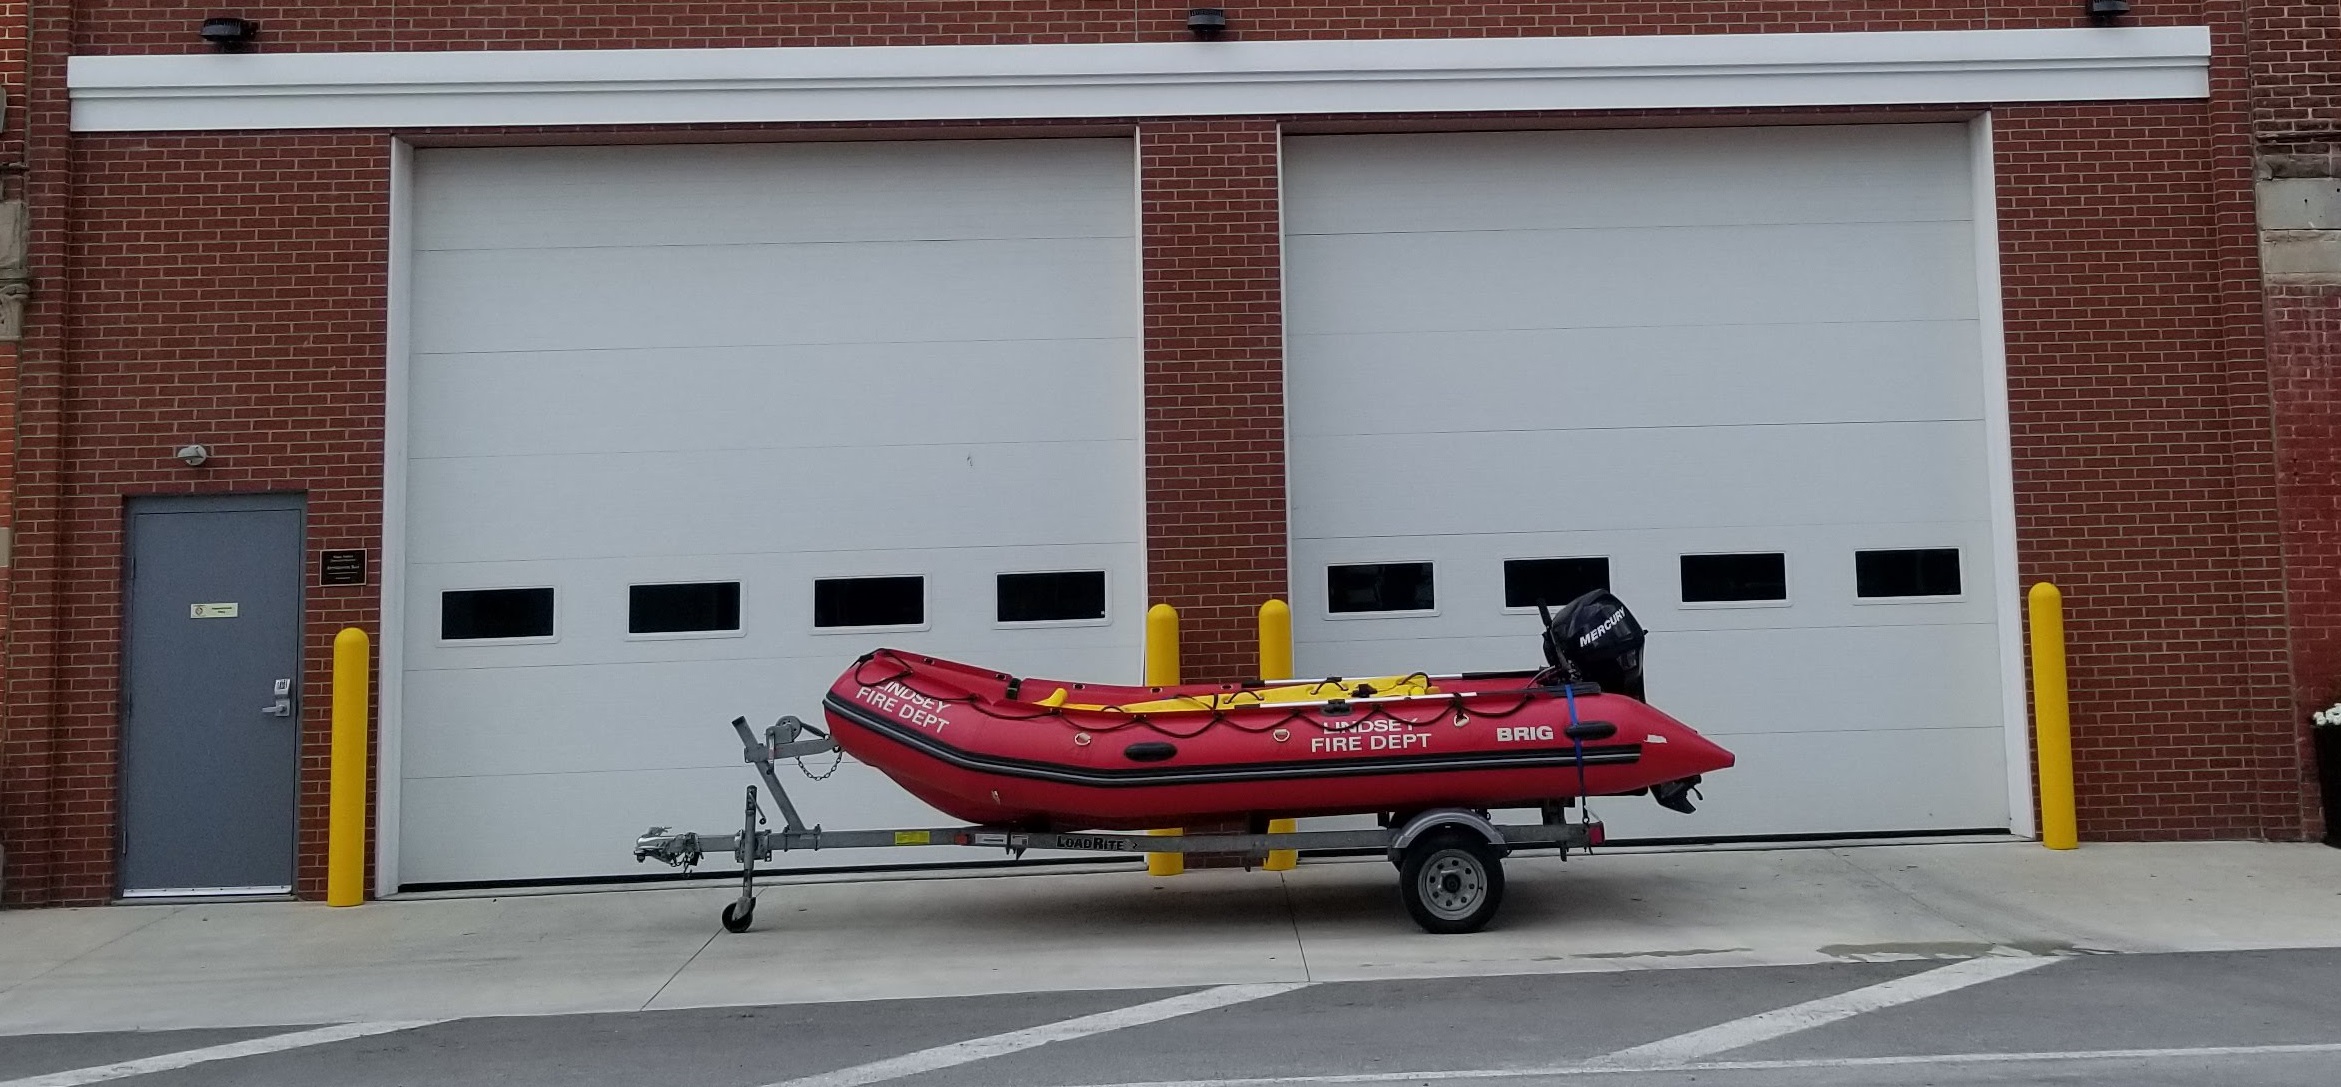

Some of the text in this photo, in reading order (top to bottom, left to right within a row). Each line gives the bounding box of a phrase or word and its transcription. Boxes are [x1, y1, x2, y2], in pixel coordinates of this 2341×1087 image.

[1579, 606, 1626, 648] MERCURY
[856, 686, 950, 733] FIRE DEPT
[1311, 733, 1432, 753] FIRE DEPT
[1496, 725, 1554, 742] BRIG
